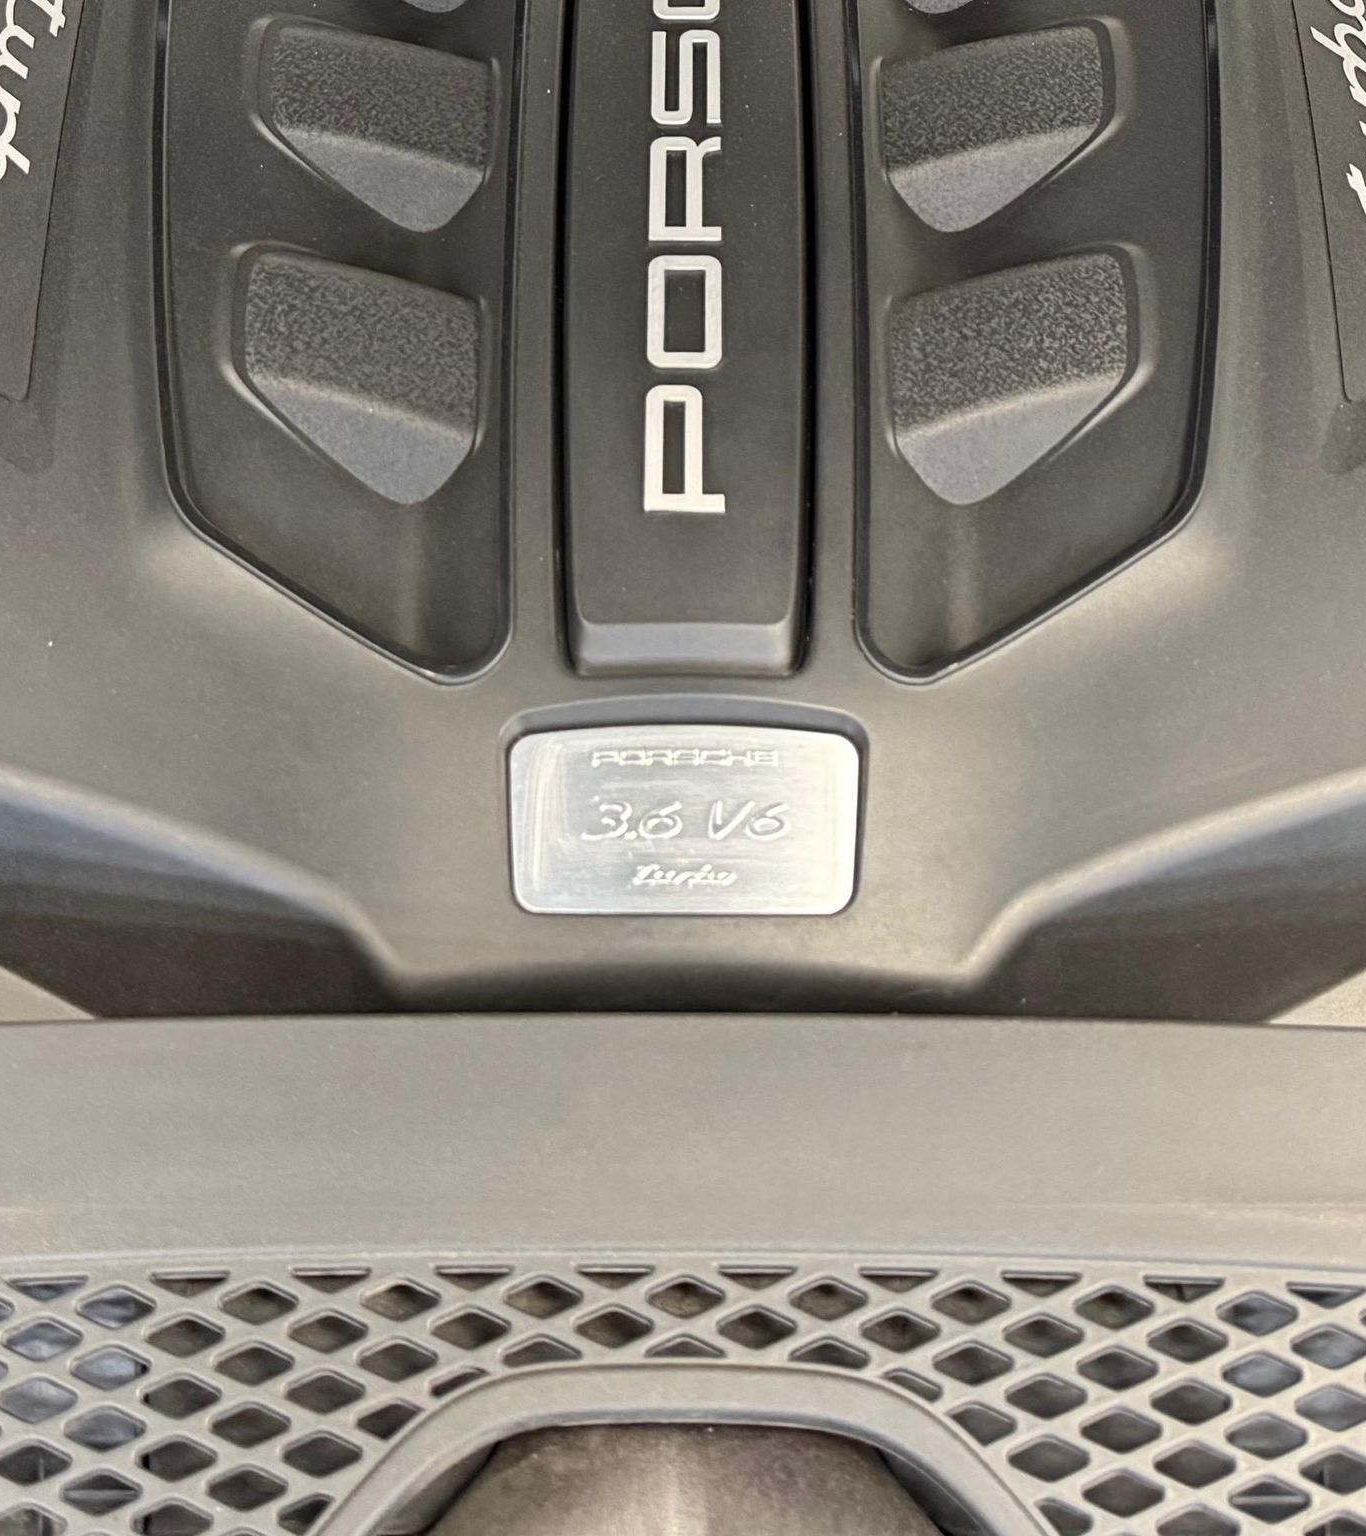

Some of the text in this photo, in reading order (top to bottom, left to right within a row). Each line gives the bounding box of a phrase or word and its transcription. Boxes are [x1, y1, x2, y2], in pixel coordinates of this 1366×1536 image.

[591, 748, 780, 767] PORSCHE
[581, 799, 791, 842] 3.6 V6
[632, 863, 737, 887] turbo
